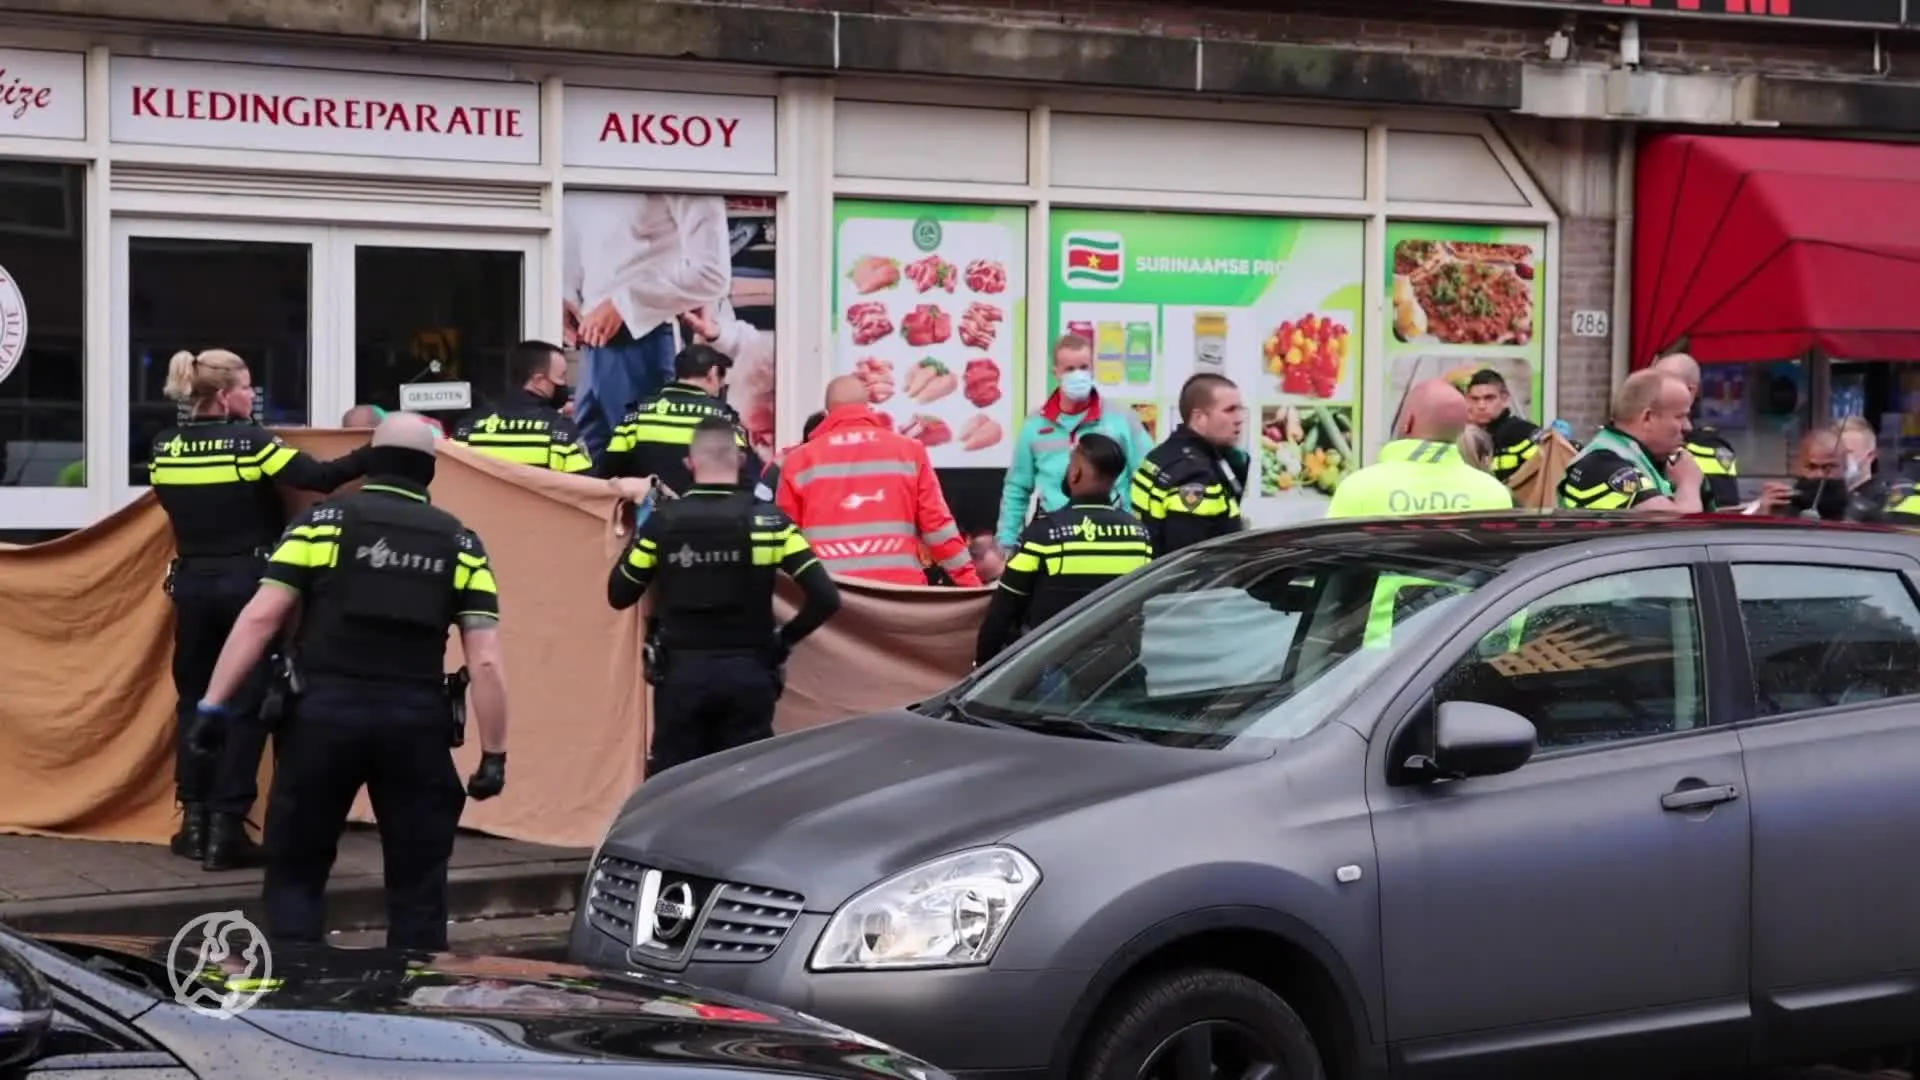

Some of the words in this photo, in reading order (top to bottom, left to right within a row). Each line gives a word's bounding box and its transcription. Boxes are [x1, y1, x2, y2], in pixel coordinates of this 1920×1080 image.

[0, 69, 51, 119] ize
[132, 86, 523, 138] KLEDINGREPARATIE
[599, 112, 739, 148] AKSOY
[1136, 256, 1250, 274] SURINAAMSE
[1576, 313, 1605, 333] 286
[408, 391, 462, 402] GESLOTEN
[356, 537, 445, 573] POLITIE
